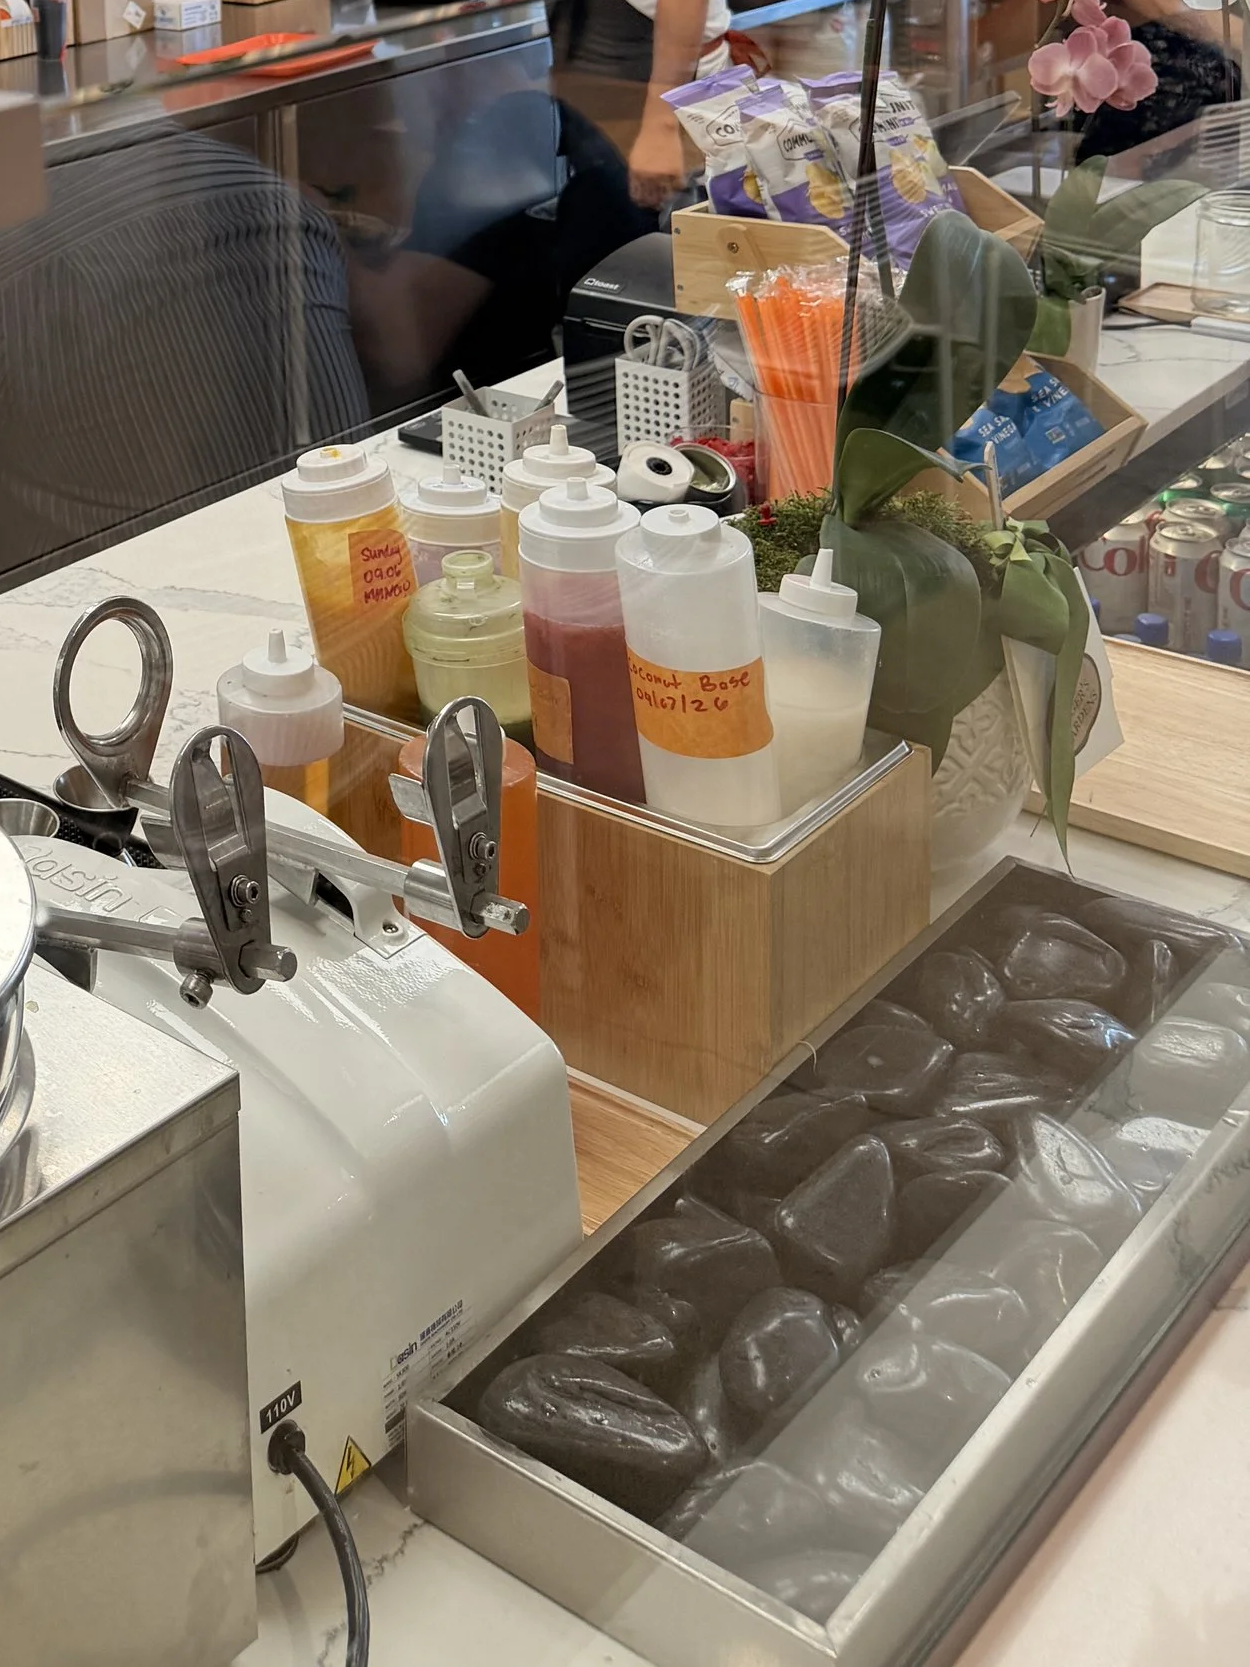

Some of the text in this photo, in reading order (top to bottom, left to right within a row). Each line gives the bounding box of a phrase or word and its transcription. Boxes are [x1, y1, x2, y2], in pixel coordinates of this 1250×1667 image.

[978, 422, 995, 438] SEA
[361, 544, 403, 565] Sunday
[699, 670, 751, 692] Base
[265, 1390, 296, 1424] 110V
